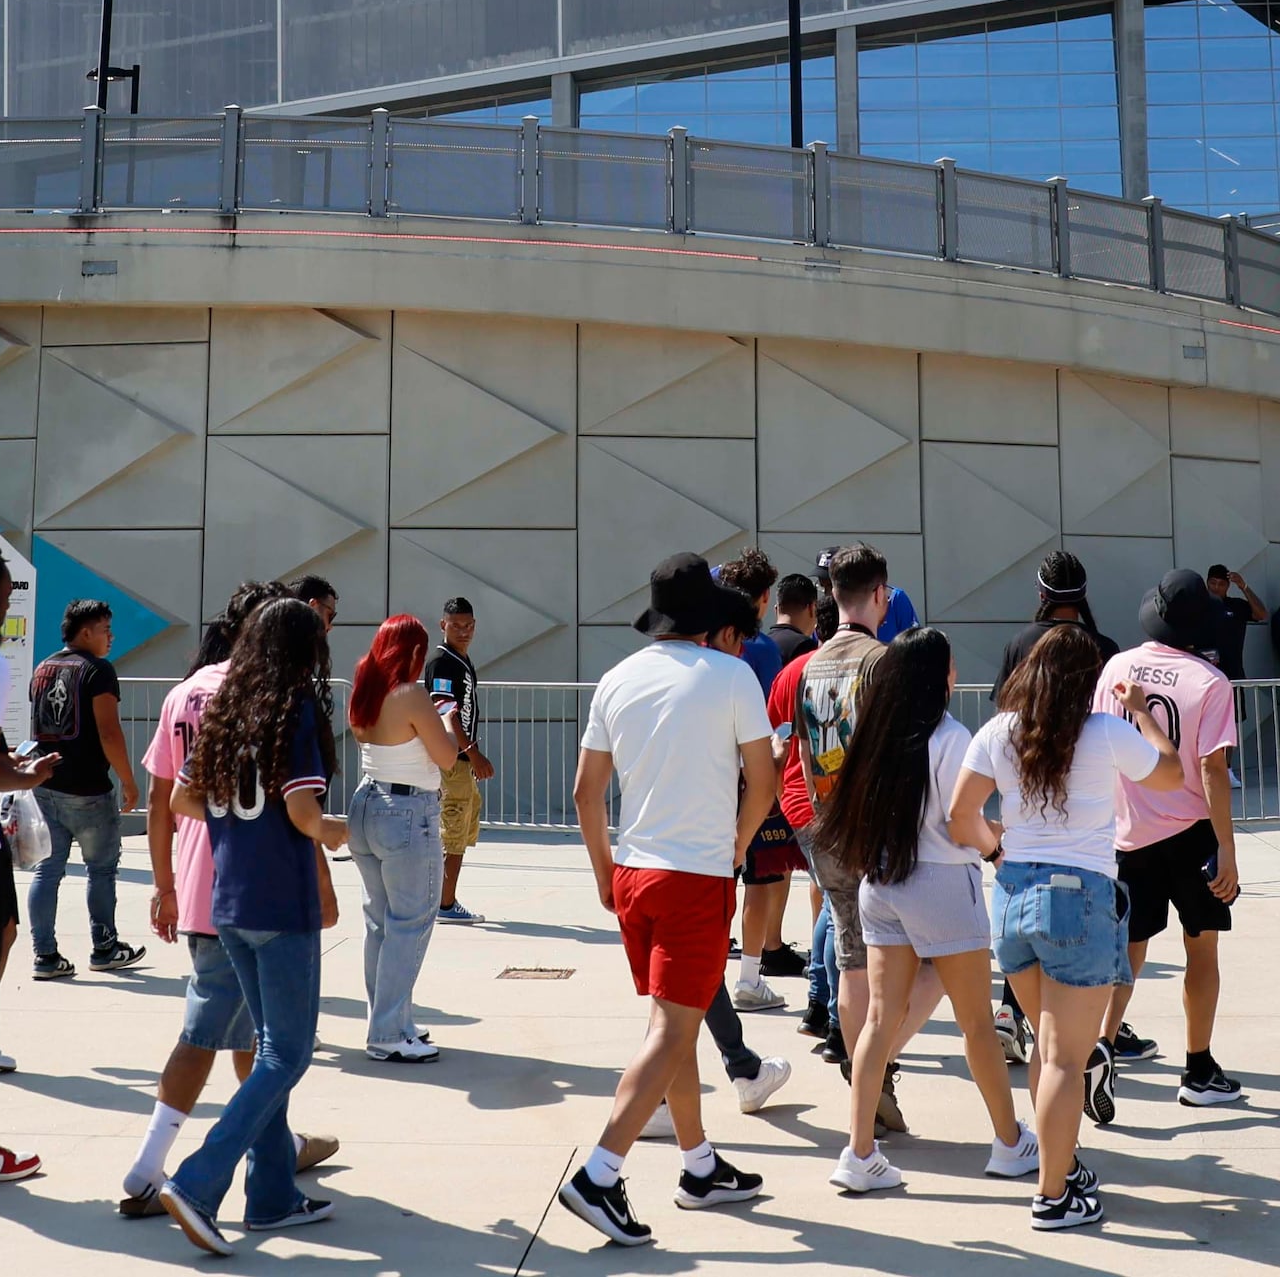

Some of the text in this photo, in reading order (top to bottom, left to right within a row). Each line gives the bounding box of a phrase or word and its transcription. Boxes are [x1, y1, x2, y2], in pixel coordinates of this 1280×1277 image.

[1128, 664, 1180, 687] MESSI
[460, 671, 474, 736] uatemala
[760, 828, 787, 842] 1899
